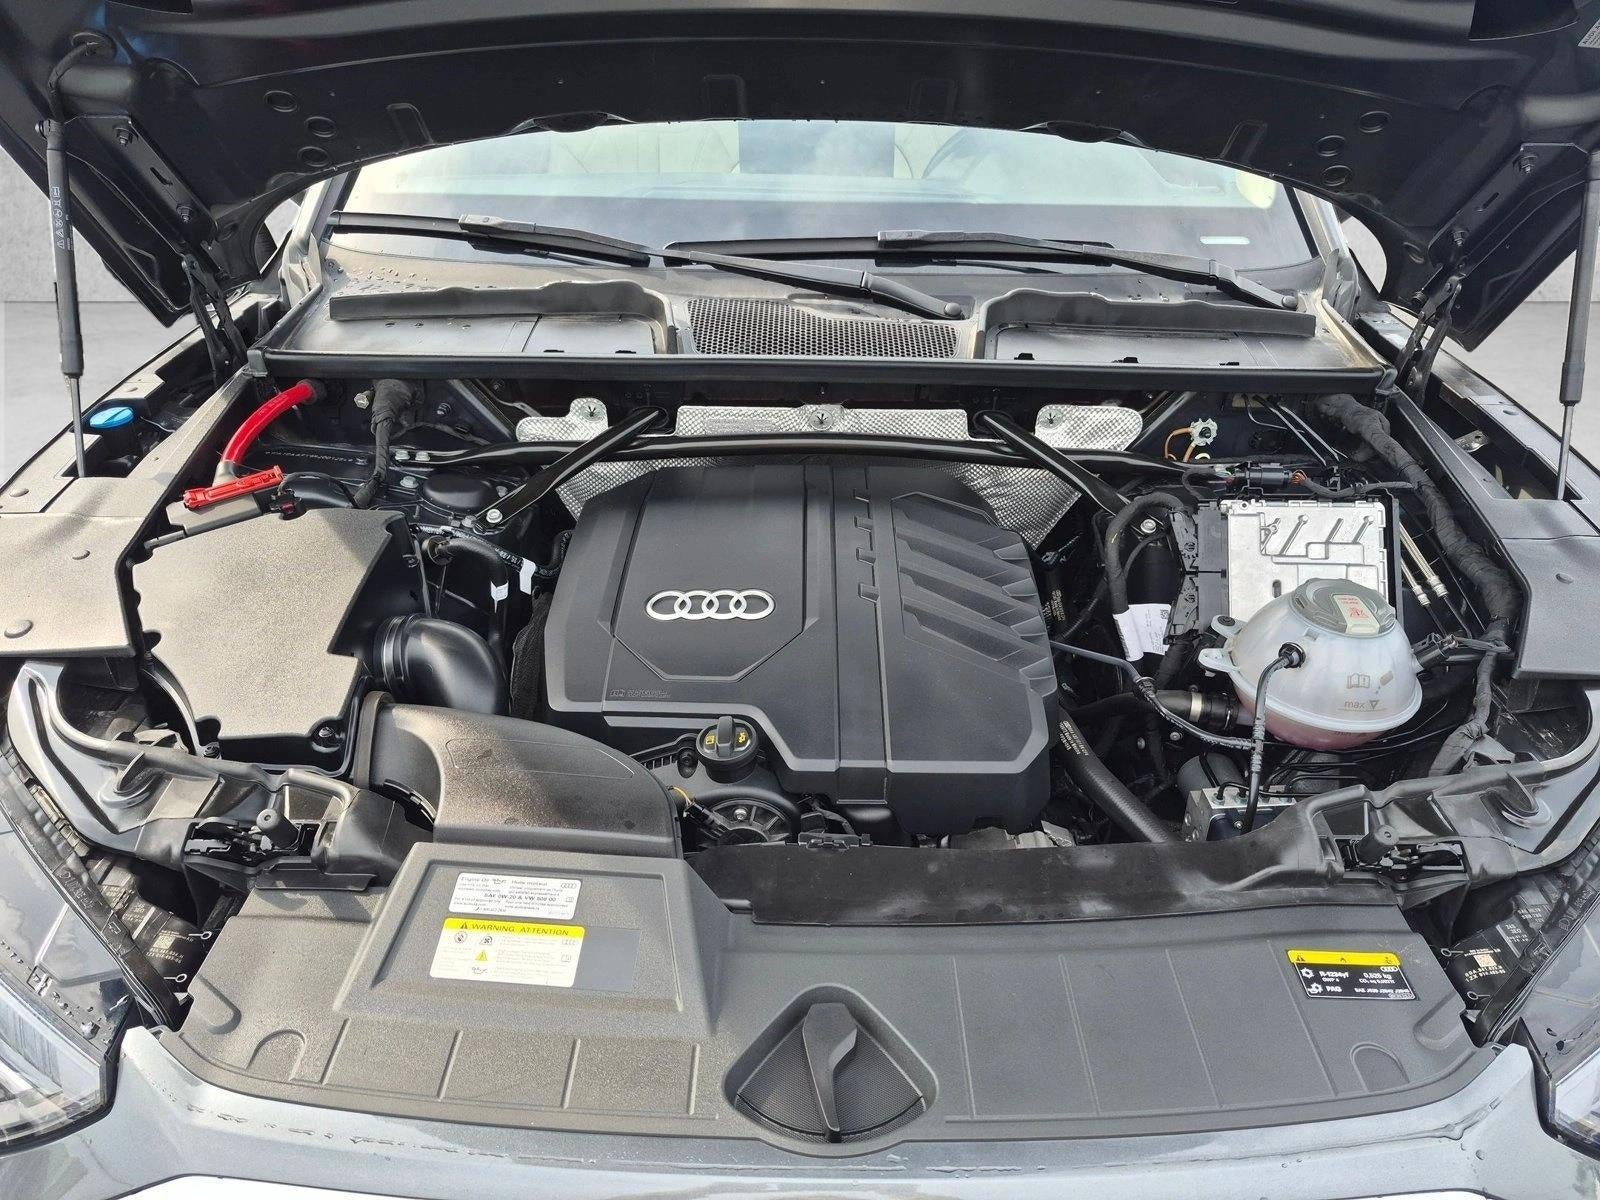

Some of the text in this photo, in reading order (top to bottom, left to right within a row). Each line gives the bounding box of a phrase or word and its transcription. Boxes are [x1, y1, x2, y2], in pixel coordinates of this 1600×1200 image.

[1344, 701, 1365, 709] max
[472, 923, 569, 936] WARNING ATTENTION
